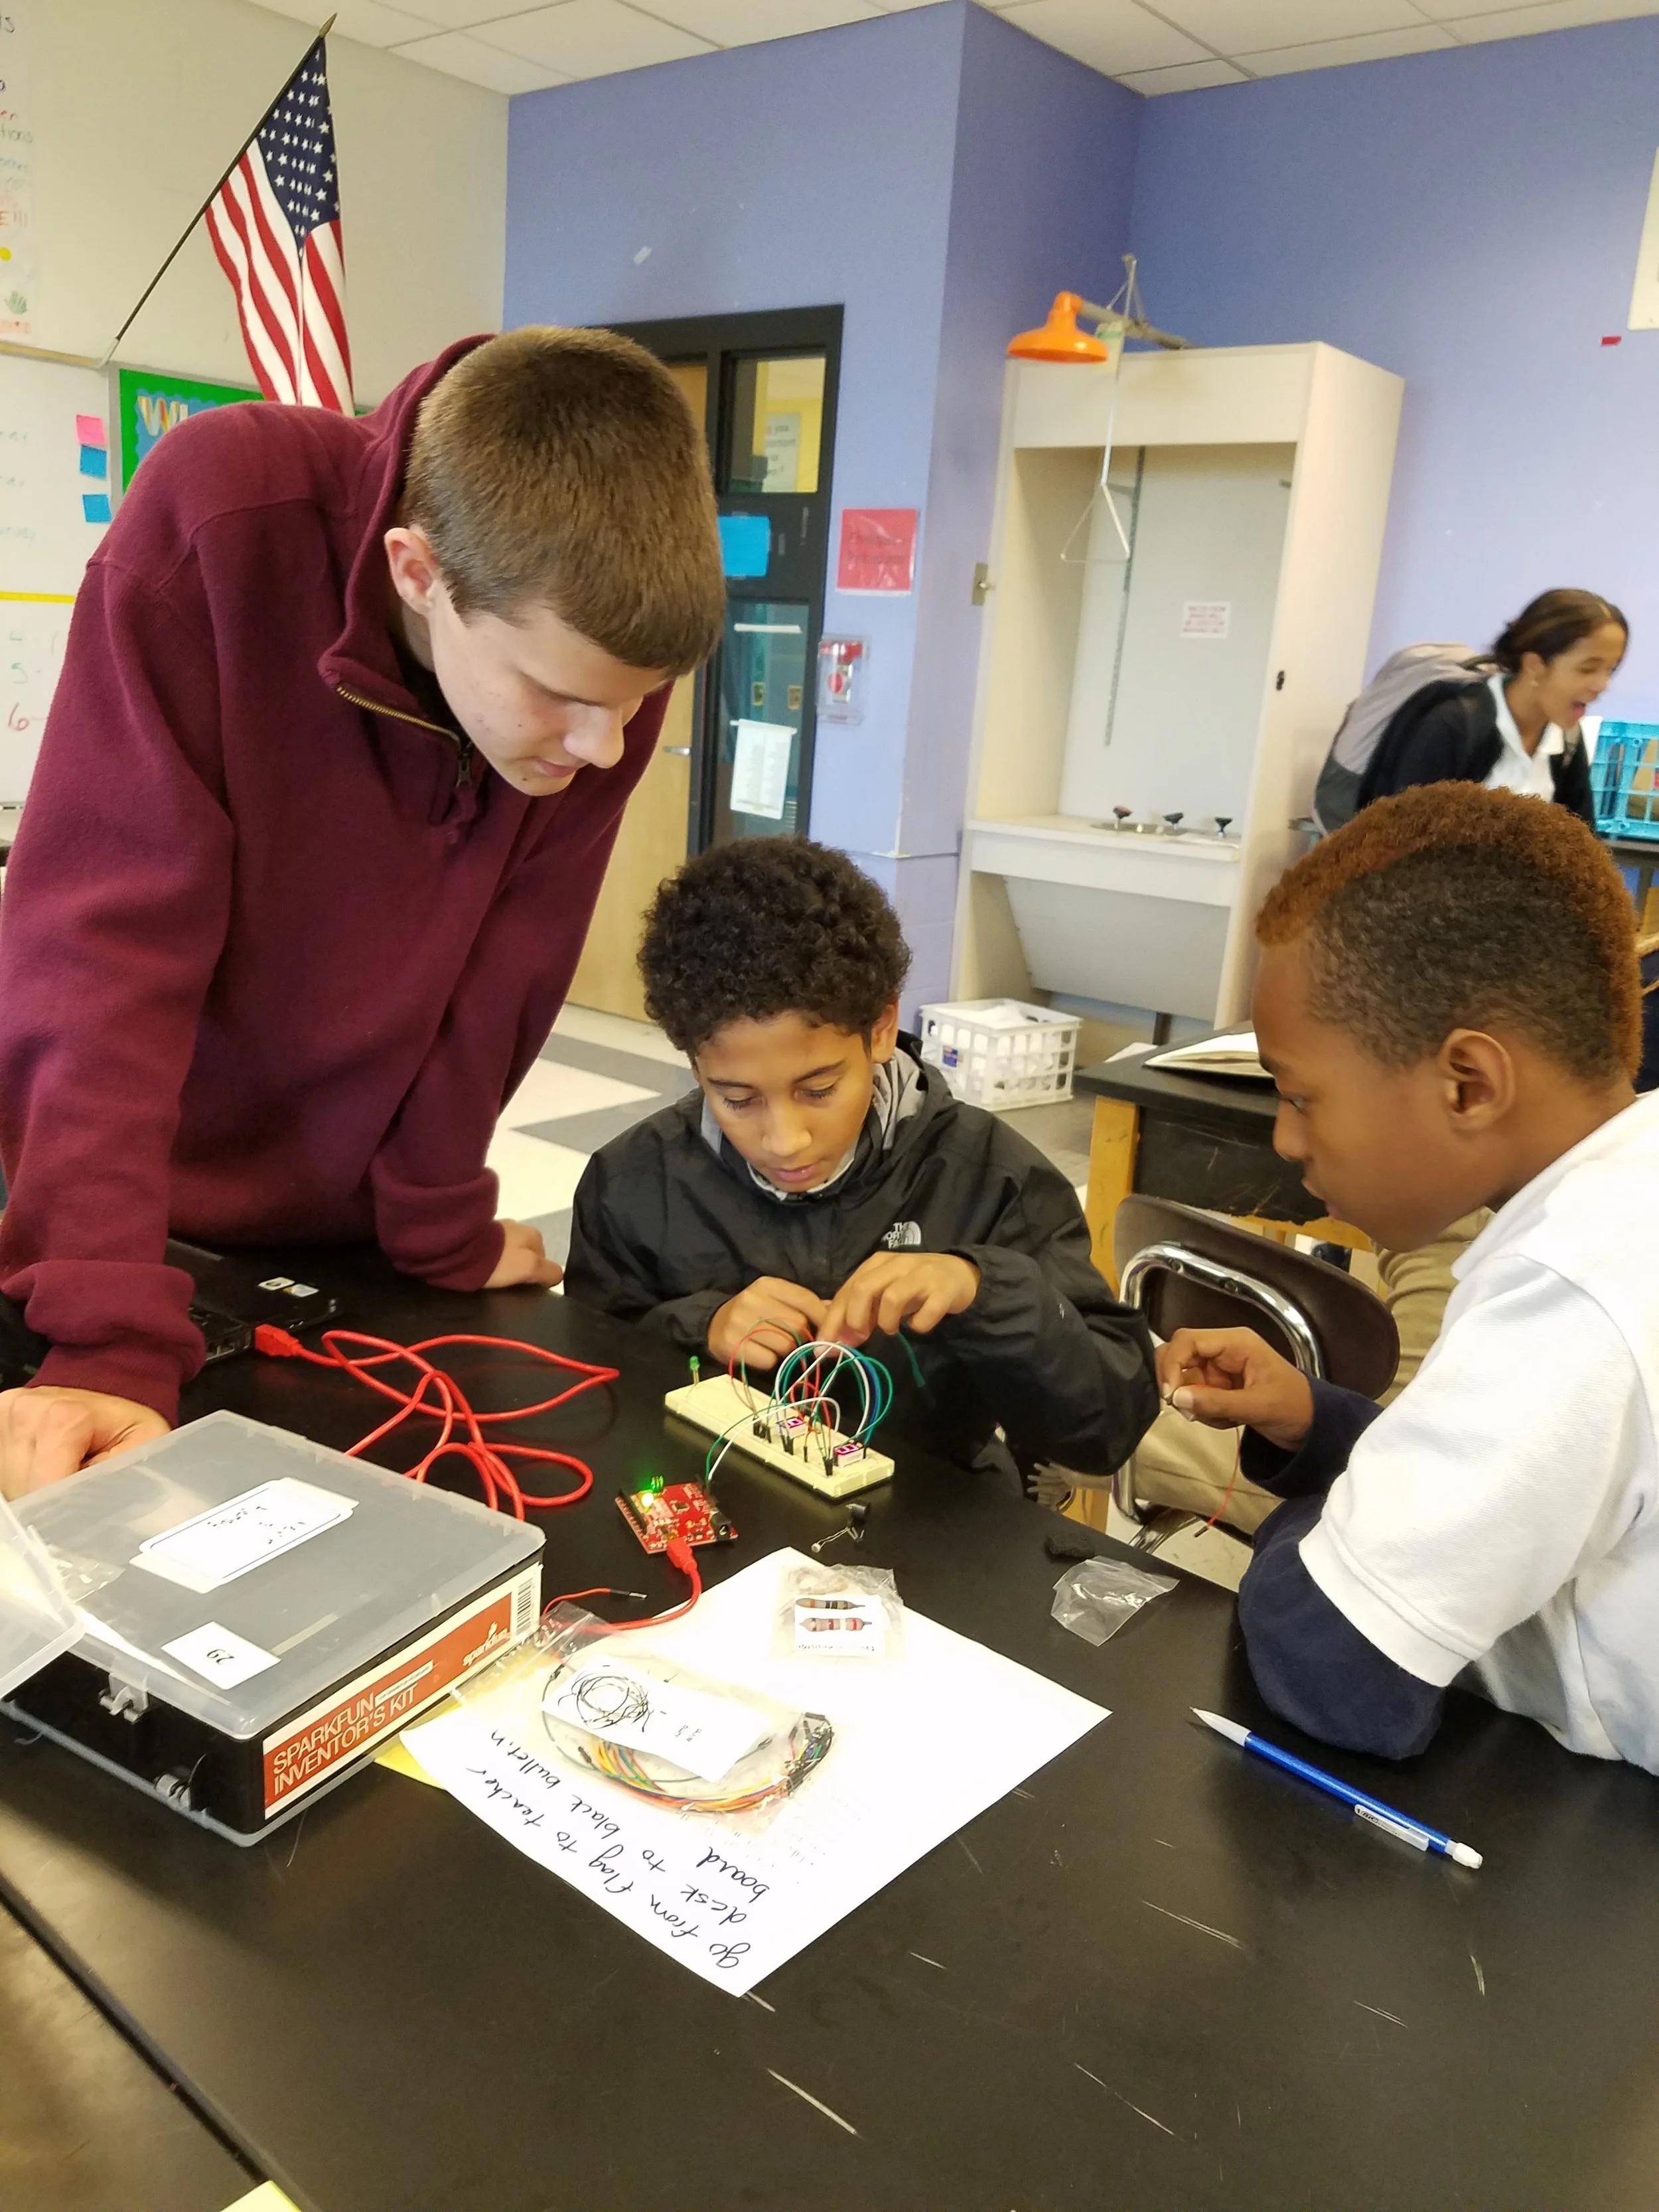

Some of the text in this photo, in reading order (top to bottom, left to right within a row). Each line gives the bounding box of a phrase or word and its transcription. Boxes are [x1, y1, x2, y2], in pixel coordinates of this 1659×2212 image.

[8, 701, 30, 731] 6
[273, 1692, 374, 1775] SPARKFUN
[274, 1706, 386, 1796] INVENTOR'S
[390, 1682, 418, 1717] KIT
[571, 1793, 620, 1840] black
[465, 1767, 751, 1968] go from flag to teacher
[642, 1850, 666, 1872] to
[695, 1846, 770, 1903] board
[680, 1883, 747, 1926] desk
